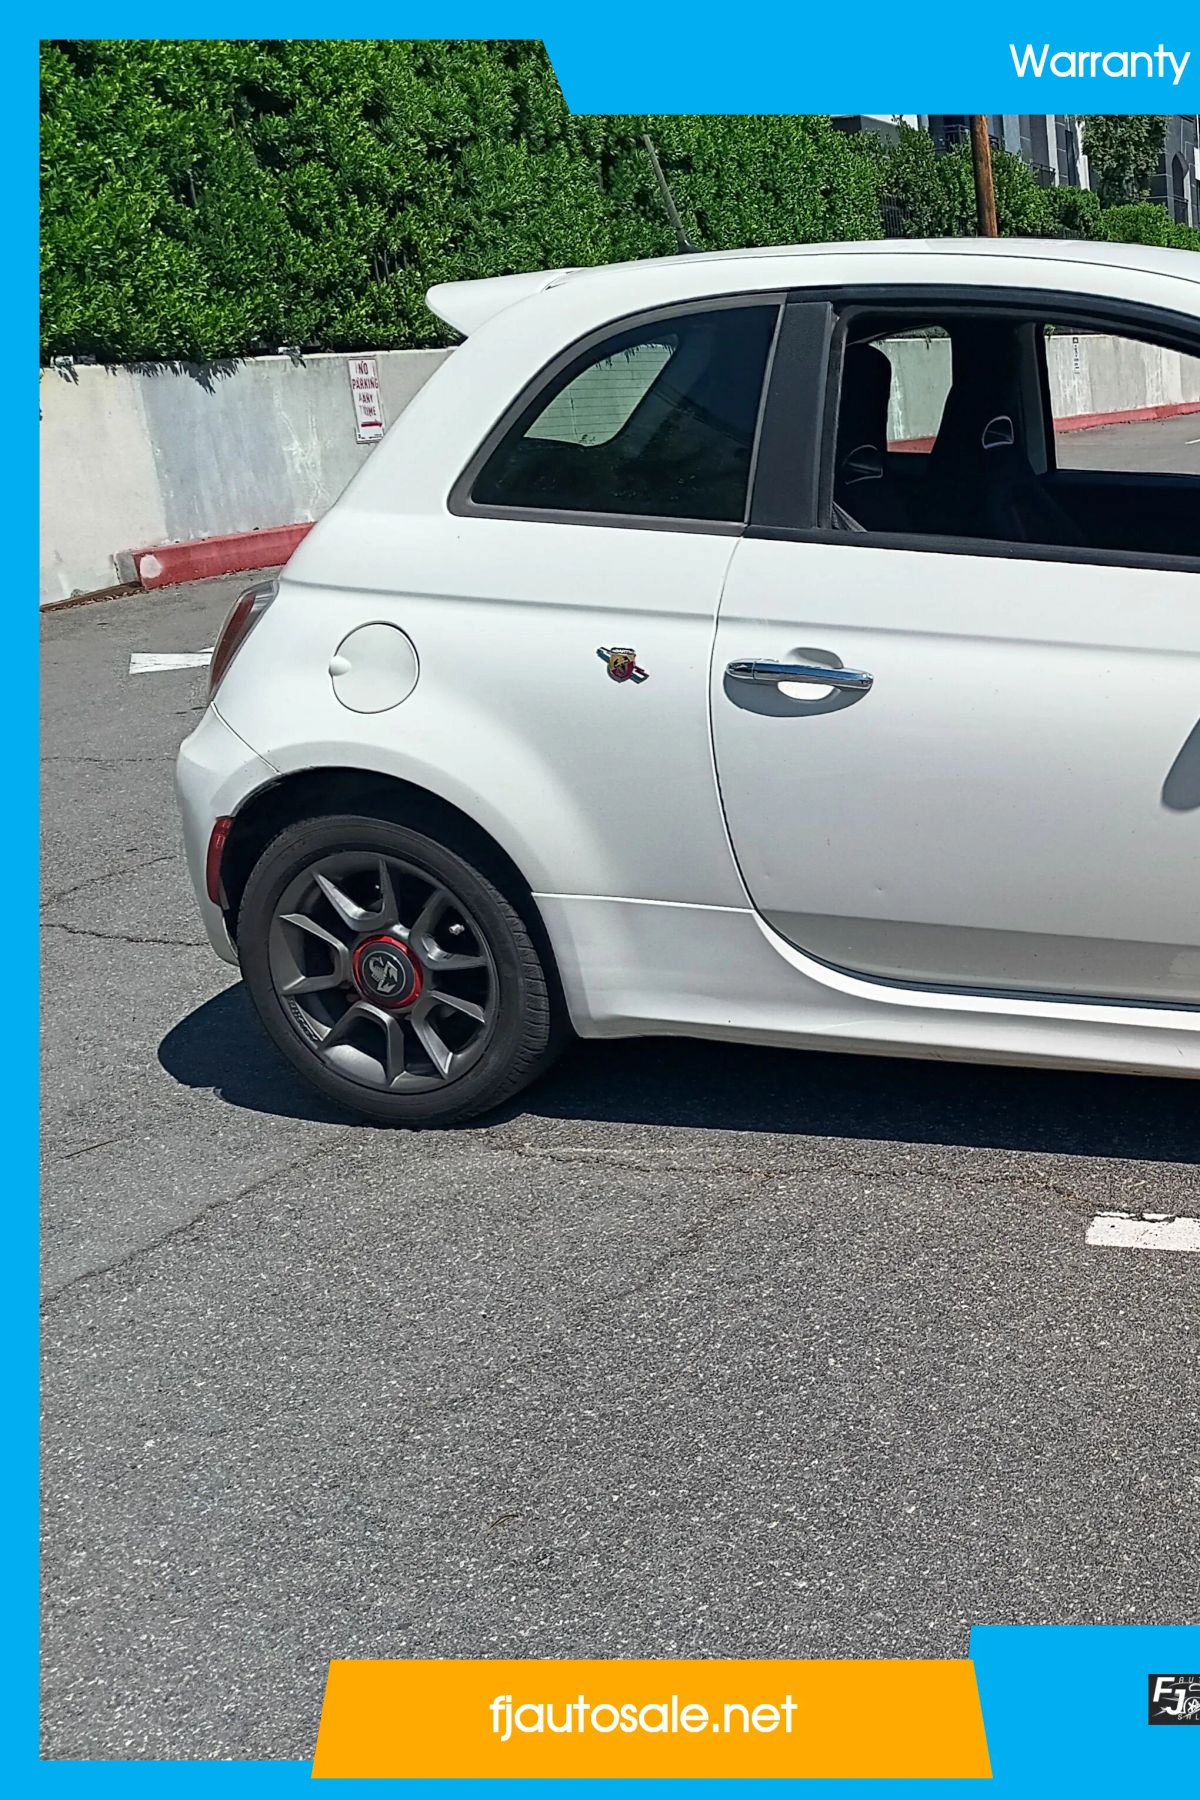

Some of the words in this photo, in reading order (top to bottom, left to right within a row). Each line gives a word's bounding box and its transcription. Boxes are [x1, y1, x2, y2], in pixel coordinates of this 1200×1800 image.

[356, 361, 369, 375] NO
[352, 378, 379, 390] PARKING
[359, 392, 374, 404] ANY
